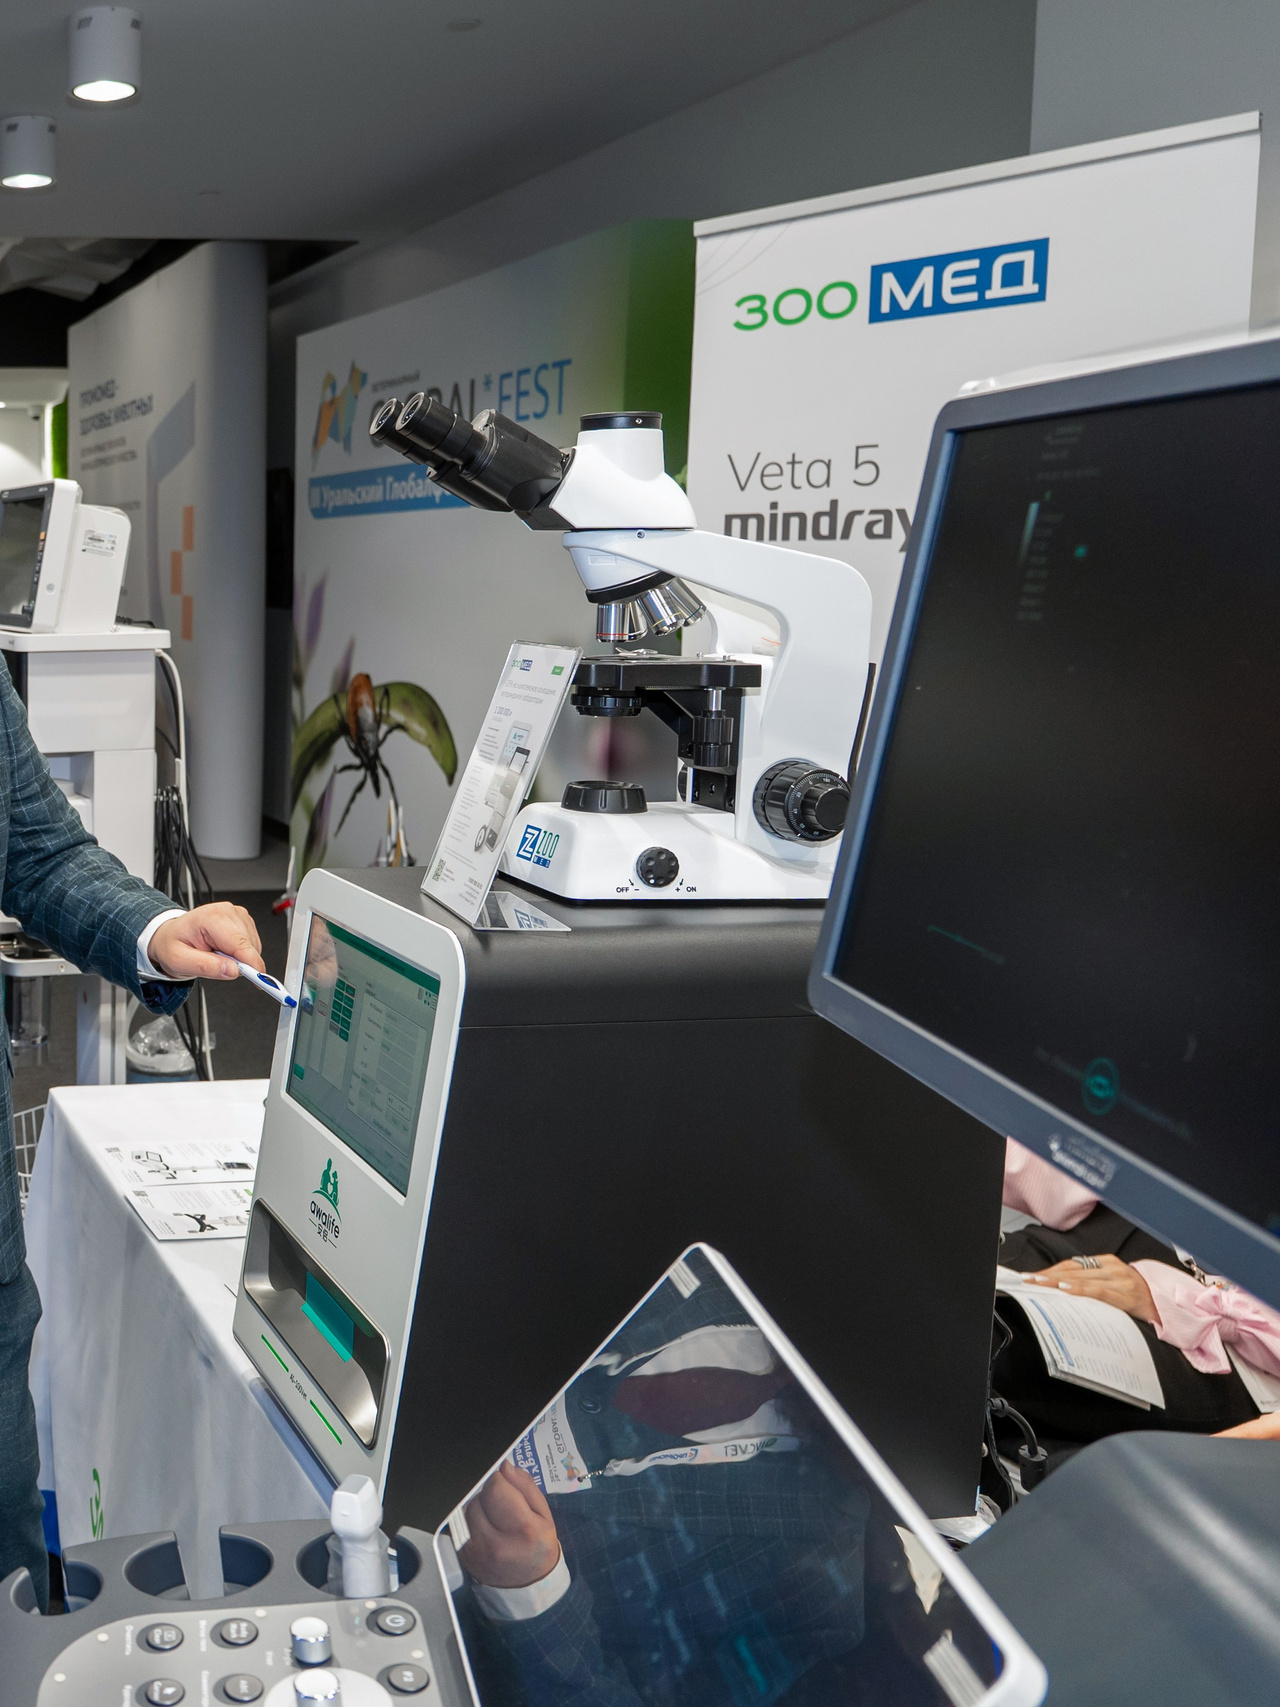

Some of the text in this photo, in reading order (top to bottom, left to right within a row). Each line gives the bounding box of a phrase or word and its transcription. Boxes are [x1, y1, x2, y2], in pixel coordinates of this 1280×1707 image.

[880, 248, 1039, 314] МЕД
[498, 358, 572, 422] FEST
[726, 443, 881, 493] Veta 5
[724, 499, 914, 554] mindray
[533, 855, 550, 868] MED
[535, 830, 560, 859] ZOO
[310, 1200, 340, 1239] awalife
